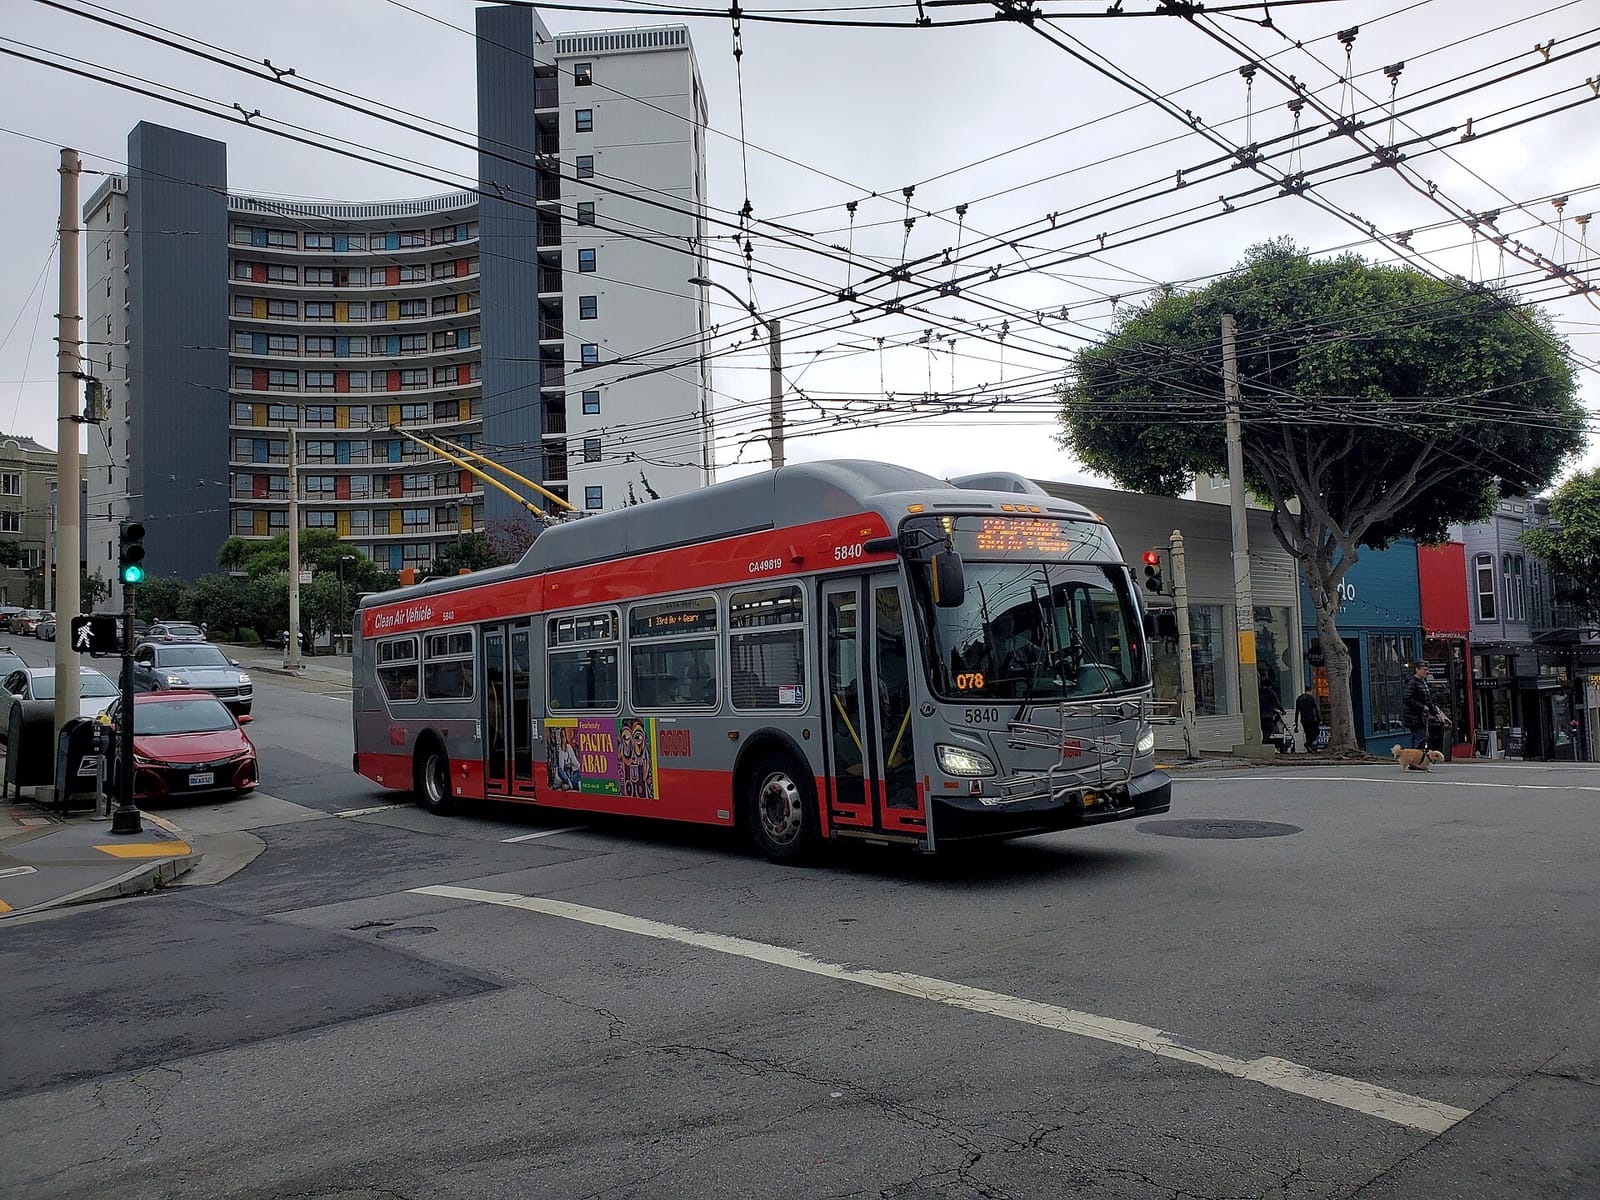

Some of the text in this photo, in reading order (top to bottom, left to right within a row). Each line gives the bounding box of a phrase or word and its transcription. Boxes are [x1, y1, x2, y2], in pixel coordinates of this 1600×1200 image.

[834, 543, 862, 561] 5840
[748, 558, 782, 573] CA49819
[374, 605, 432, 628] Clean Air Vehicle
[956, 673, 985, 689] 078
[965, 708, 999, 724] 5840
[580, 733, 614, 752] PACITA
[581, 754, 608, 774] ABAD
